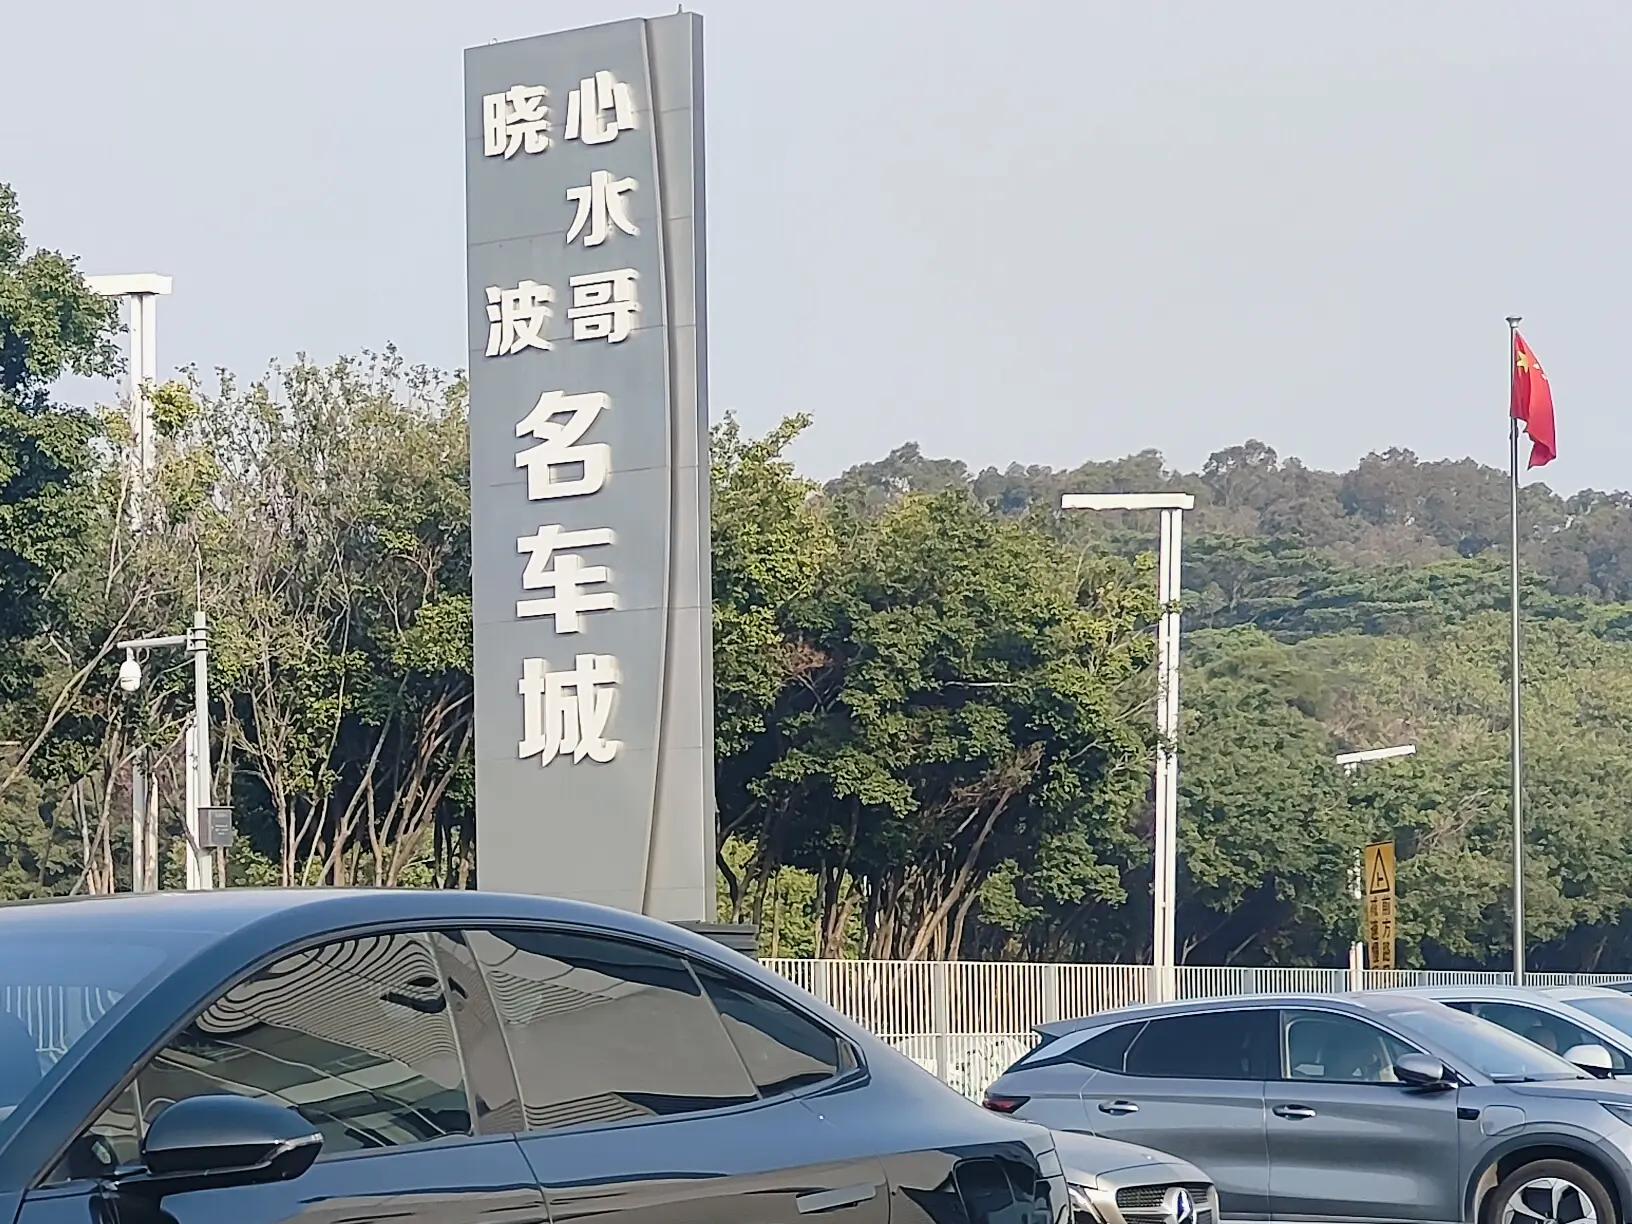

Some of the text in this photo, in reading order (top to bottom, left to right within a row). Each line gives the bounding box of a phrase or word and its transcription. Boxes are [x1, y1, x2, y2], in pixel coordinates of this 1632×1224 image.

[483, 85, 554, 357] 晓波
[565, 71, 638, 343] 心水哥
[516, 390, 623, 766] 名车城
